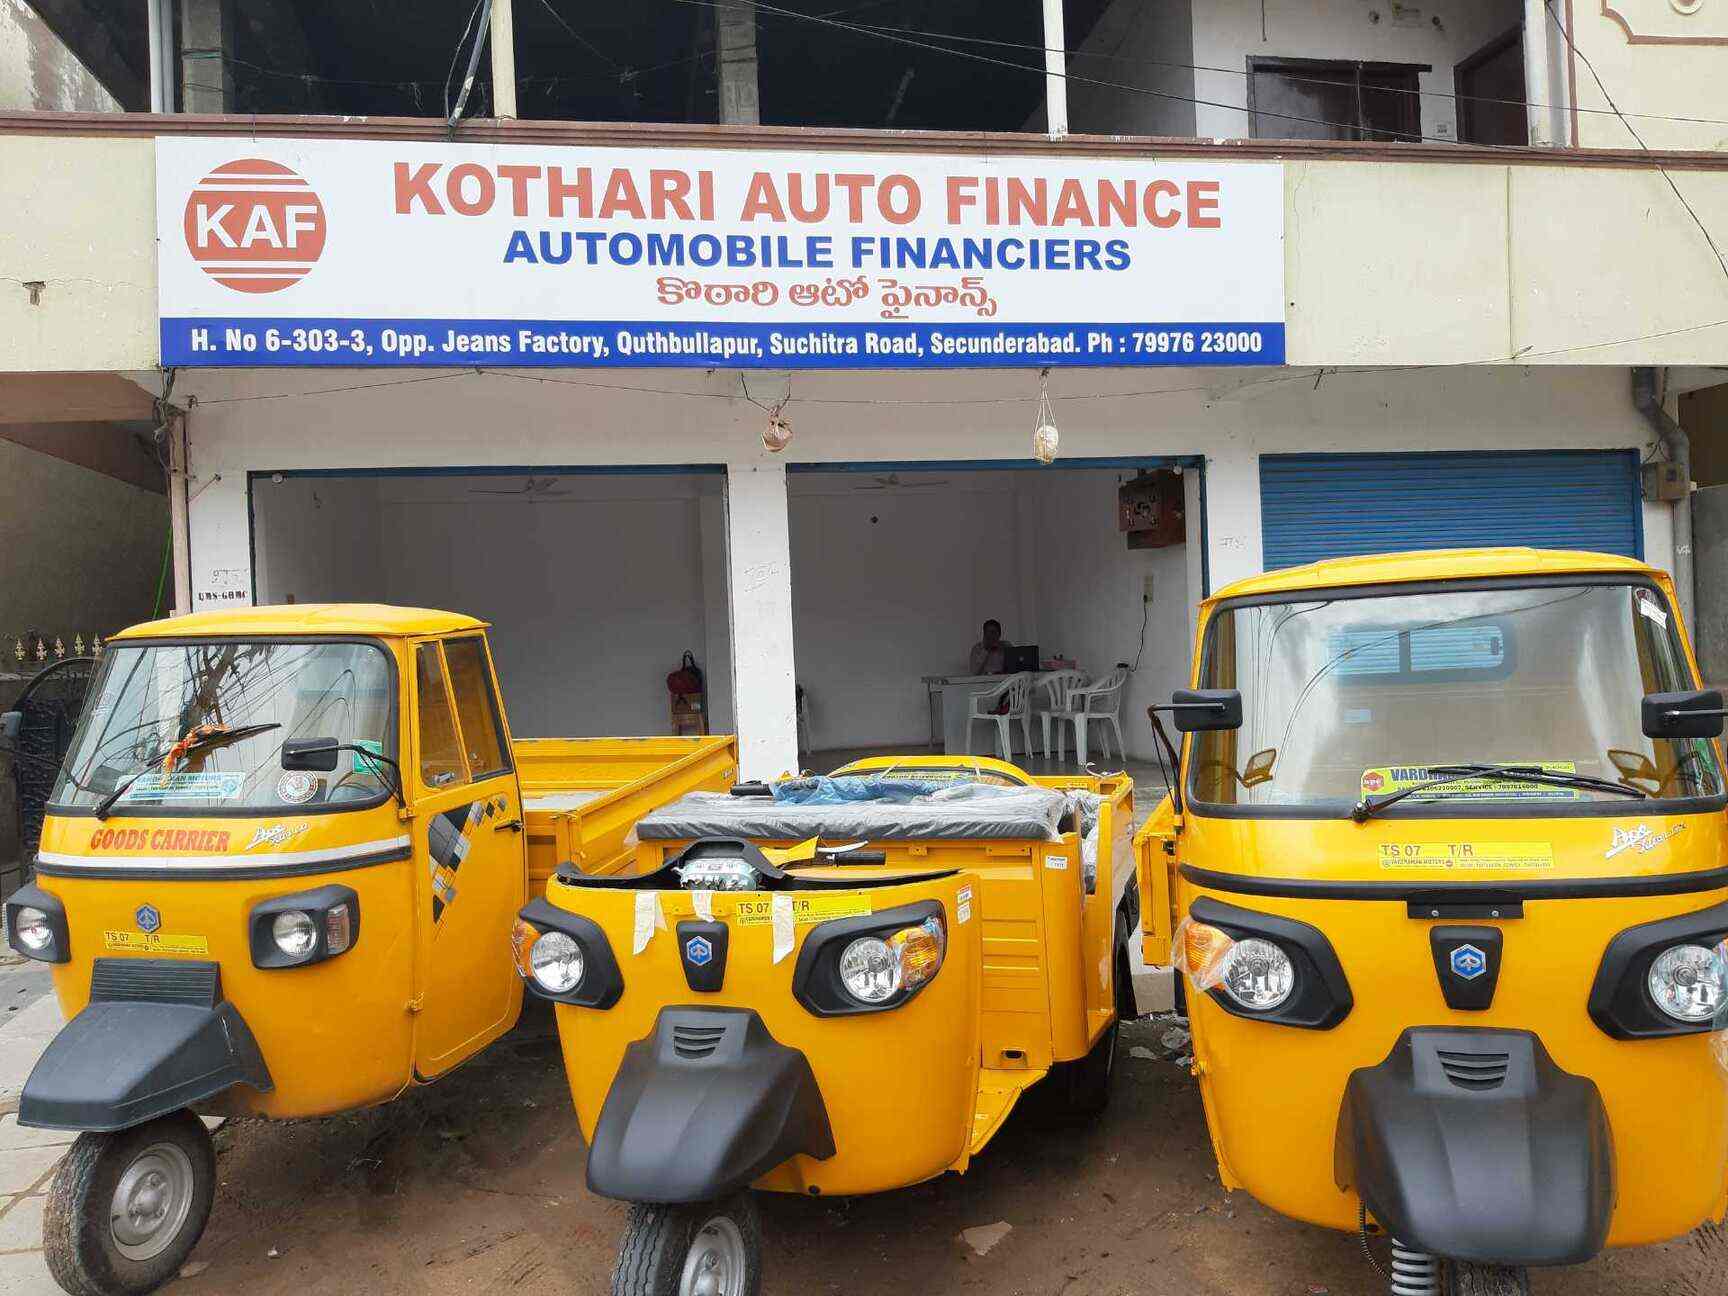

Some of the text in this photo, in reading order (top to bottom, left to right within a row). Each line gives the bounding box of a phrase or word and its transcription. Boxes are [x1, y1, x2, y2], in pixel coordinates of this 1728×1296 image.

[394, 162, 1223, 230] KOTHARI AUTO FINANCE
[196, 204, 318, 249] KAF
[503, 230, 1132, 272] AUTOMOBILE FINANCIERS
[656, 276, 780, 307] కొఠారి
[789, 275, 871, 307] ఆటో
[191, 329, 217, 352] H.
[225, 329, 257, 352] No
[265, 329, 373, 356] 6-303-3,
[381, 329, 435, 357] Opp.
[442, 330, 511, 353] Jeans
[518, 331, 610, 358] Factory,
[617, 332, 763, 359] Quthbullapur,
[770, 332, 858, 355] Suchitra
[865, 332, 924, 358] Road,
[930, 332, 1081, 354] Secunderabad.
[1087, 332, 1113, 353] Ph
[1132, 332, 1194, 353] 79976
[1200, 332, 1262, 353] 23000
[90, 828, 231, 852] GOODS CARRIER
[1381, 844, 1474, 857] TS 07 T/R
[738, 902, 753, 914] TS
[756, 902, 769, 914] 07
[105, 931, 161, 944] TS 07 T/R
